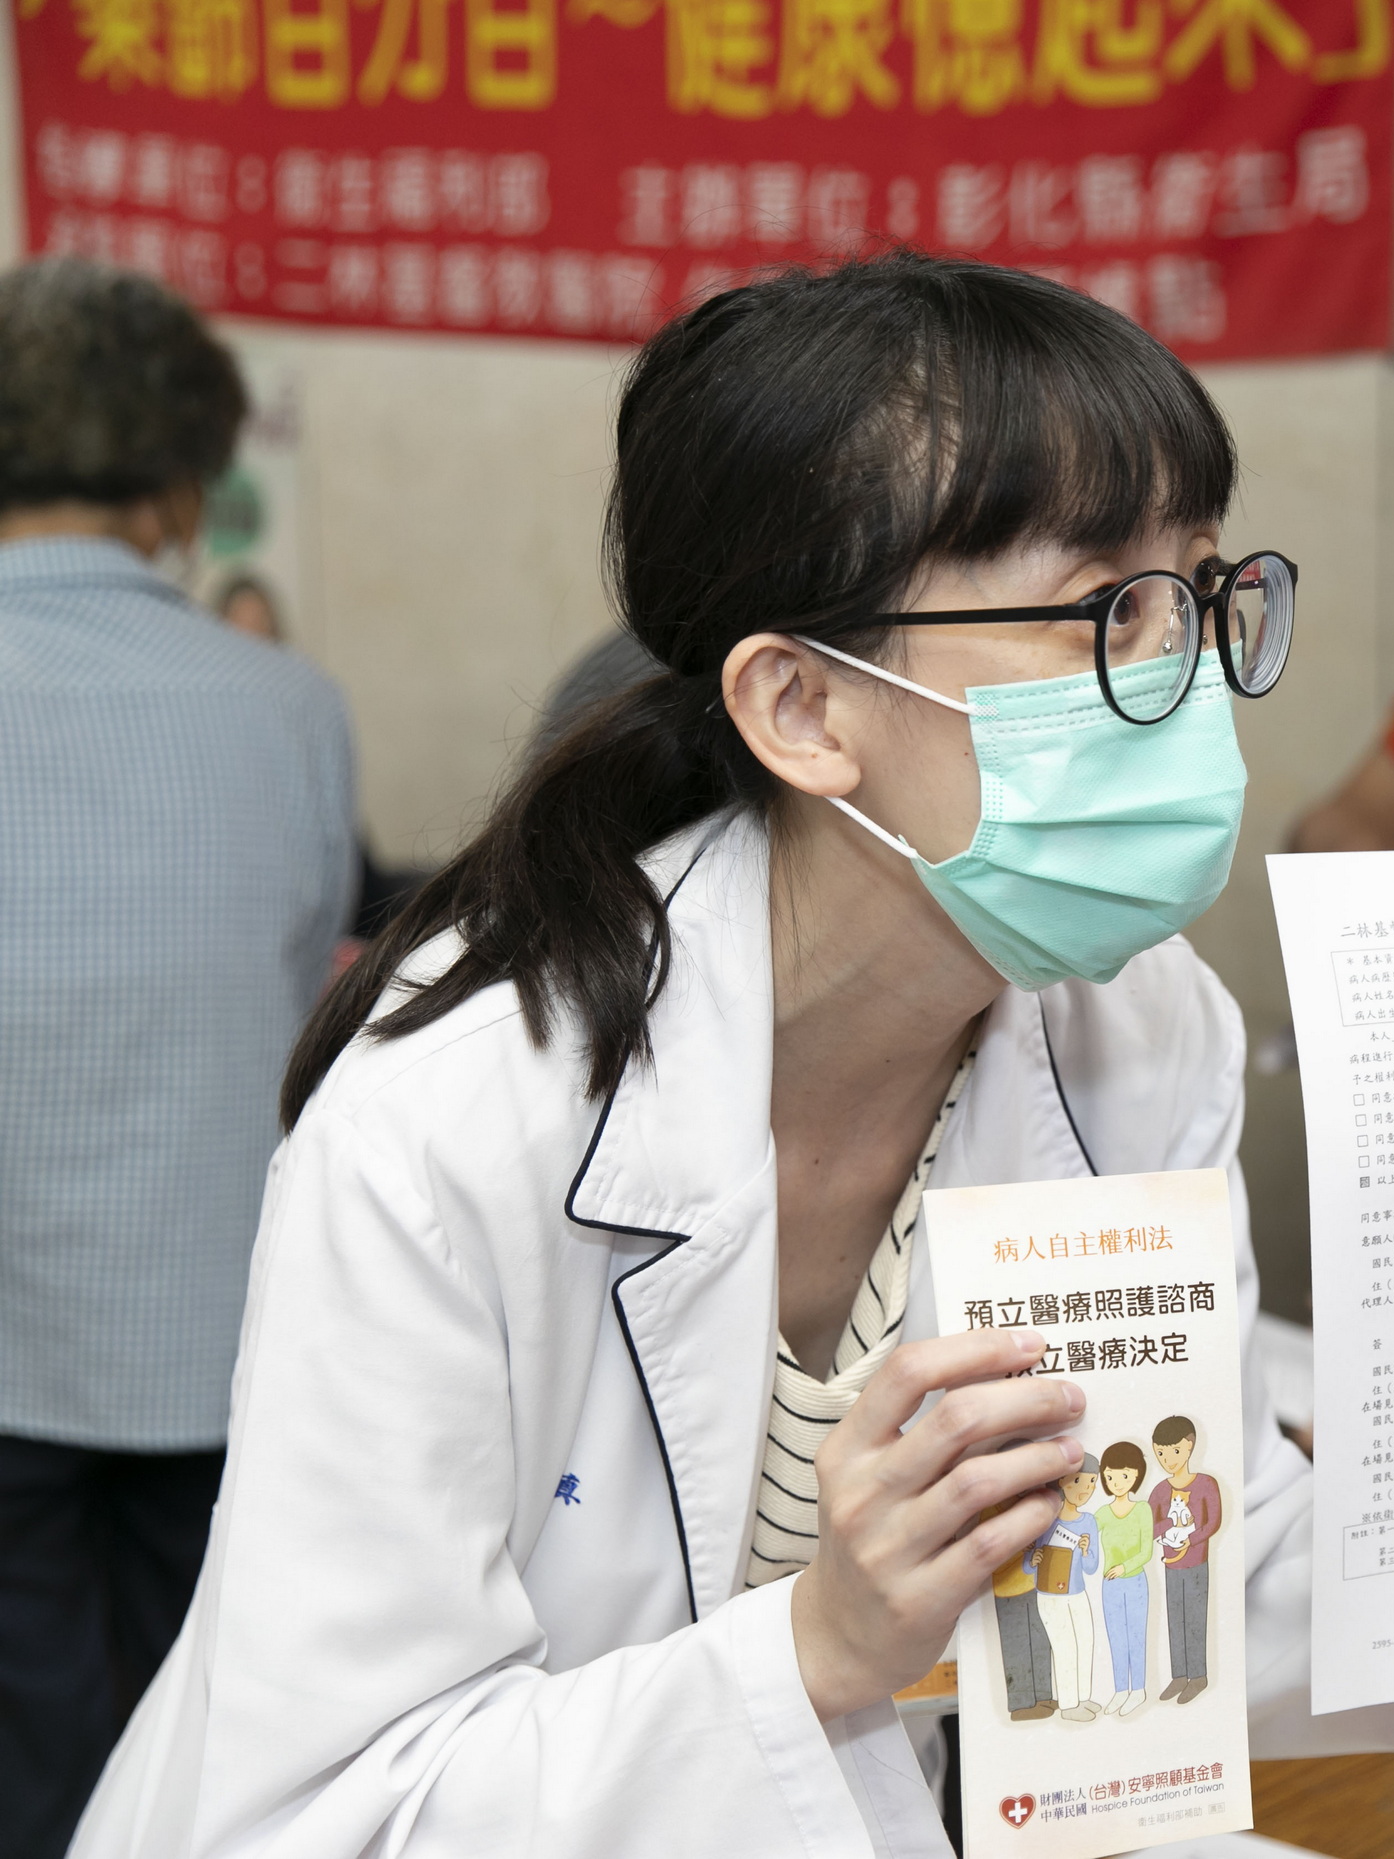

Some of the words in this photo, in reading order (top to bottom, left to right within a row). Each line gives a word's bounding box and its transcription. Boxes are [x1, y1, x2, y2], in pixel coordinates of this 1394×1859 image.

[1370, 1031, 1391, 1042] 本人
[994, 1225, 1173, 1264] 病人自主權利法
[964, 1281, 1215, 1330] 預立醫療照護諮商
[1040, 1787, 1086, 1807] 財團法人
[1091, 1799, 1128, 1815] Hospice
[1130, 1791, 1181, 1810] Foundation
[1182, 1788, 1192, 1798] of
[1193, 1783, 1225, 1797] Taiwan
[1040, 1802, 1087, 1823] 中華民國
